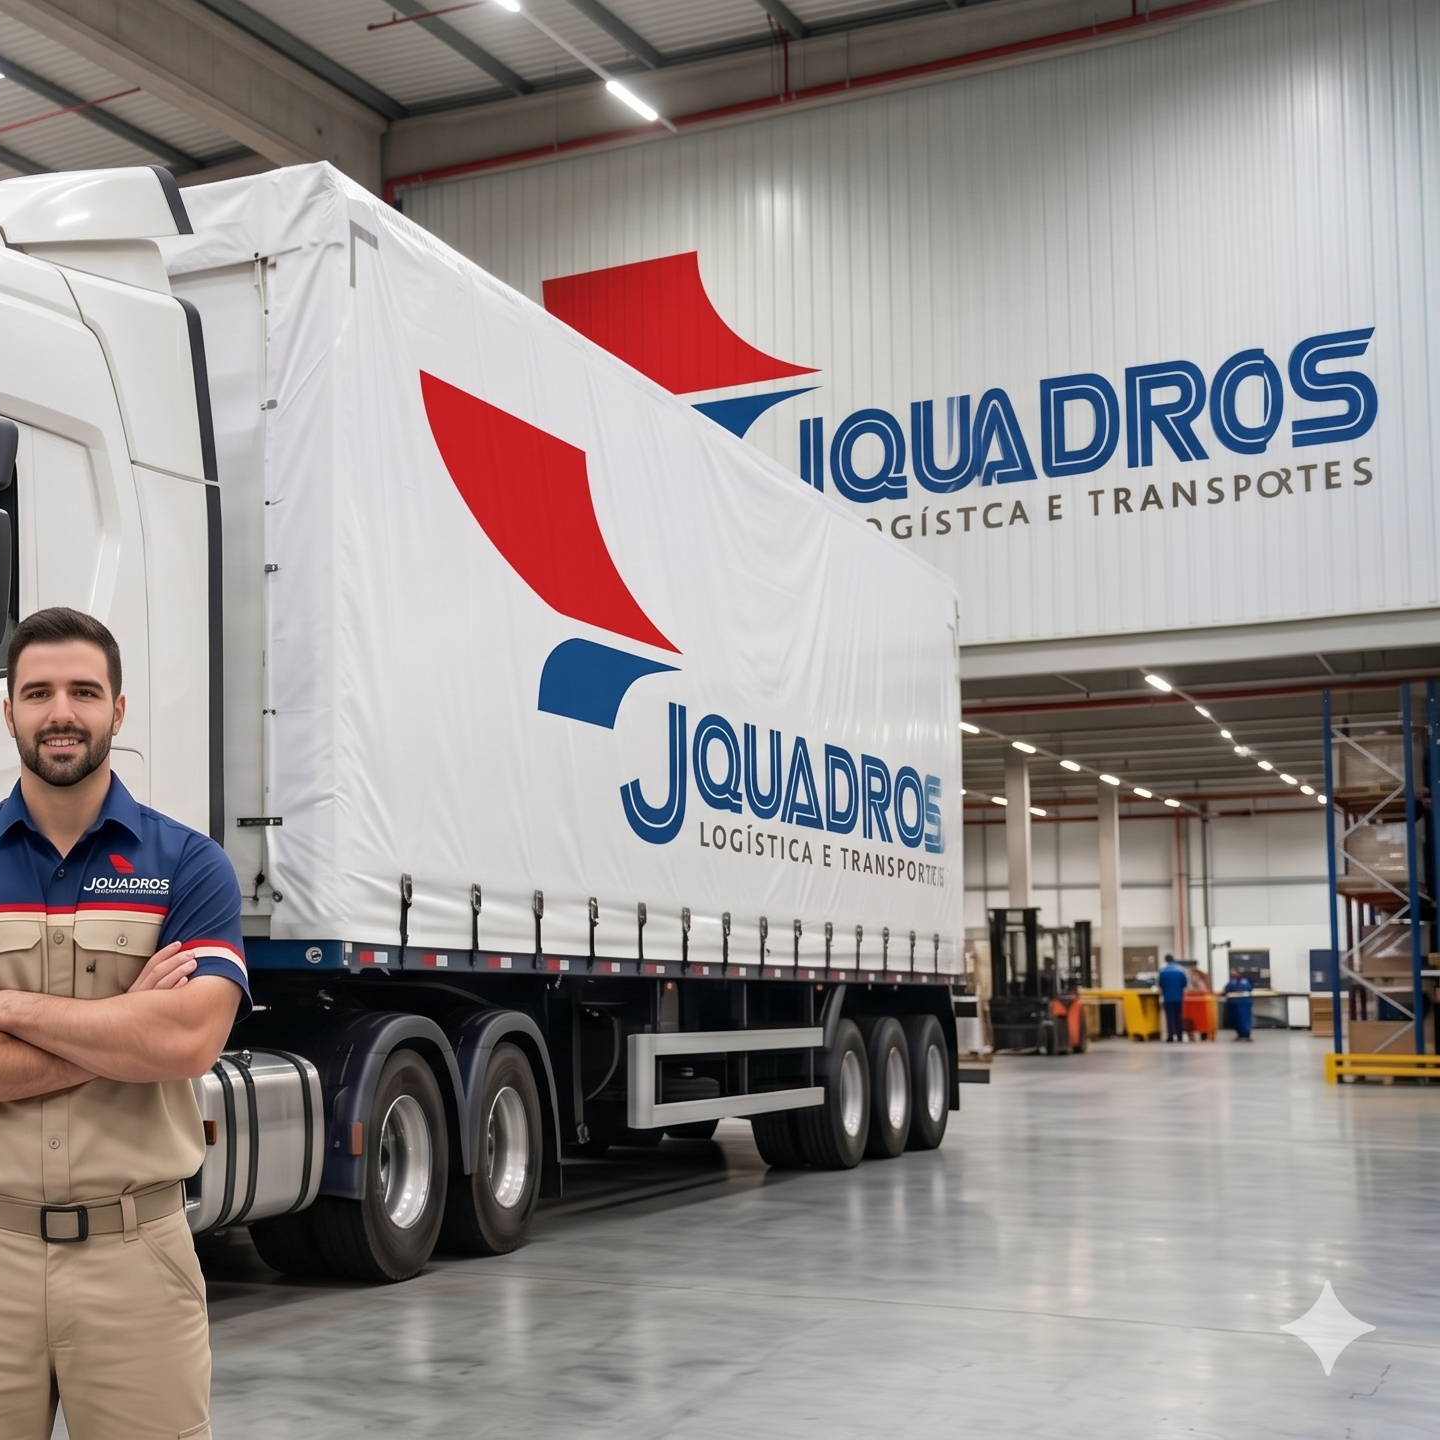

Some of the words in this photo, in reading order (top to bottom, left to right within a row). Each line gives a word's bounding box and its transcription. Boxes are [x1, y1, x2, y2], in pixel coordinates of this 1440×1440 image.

[866, 501, 1030, 540] GÍSTCA
[1049, 494, 1064, 521] E
[1089, 456, 1374, 517] TRANSPORTES
[619, 701, 946, 854] JQUADROS
[699, 821, 814, 865] LOGÍSTICA
[823, 844, 832, 868] E
